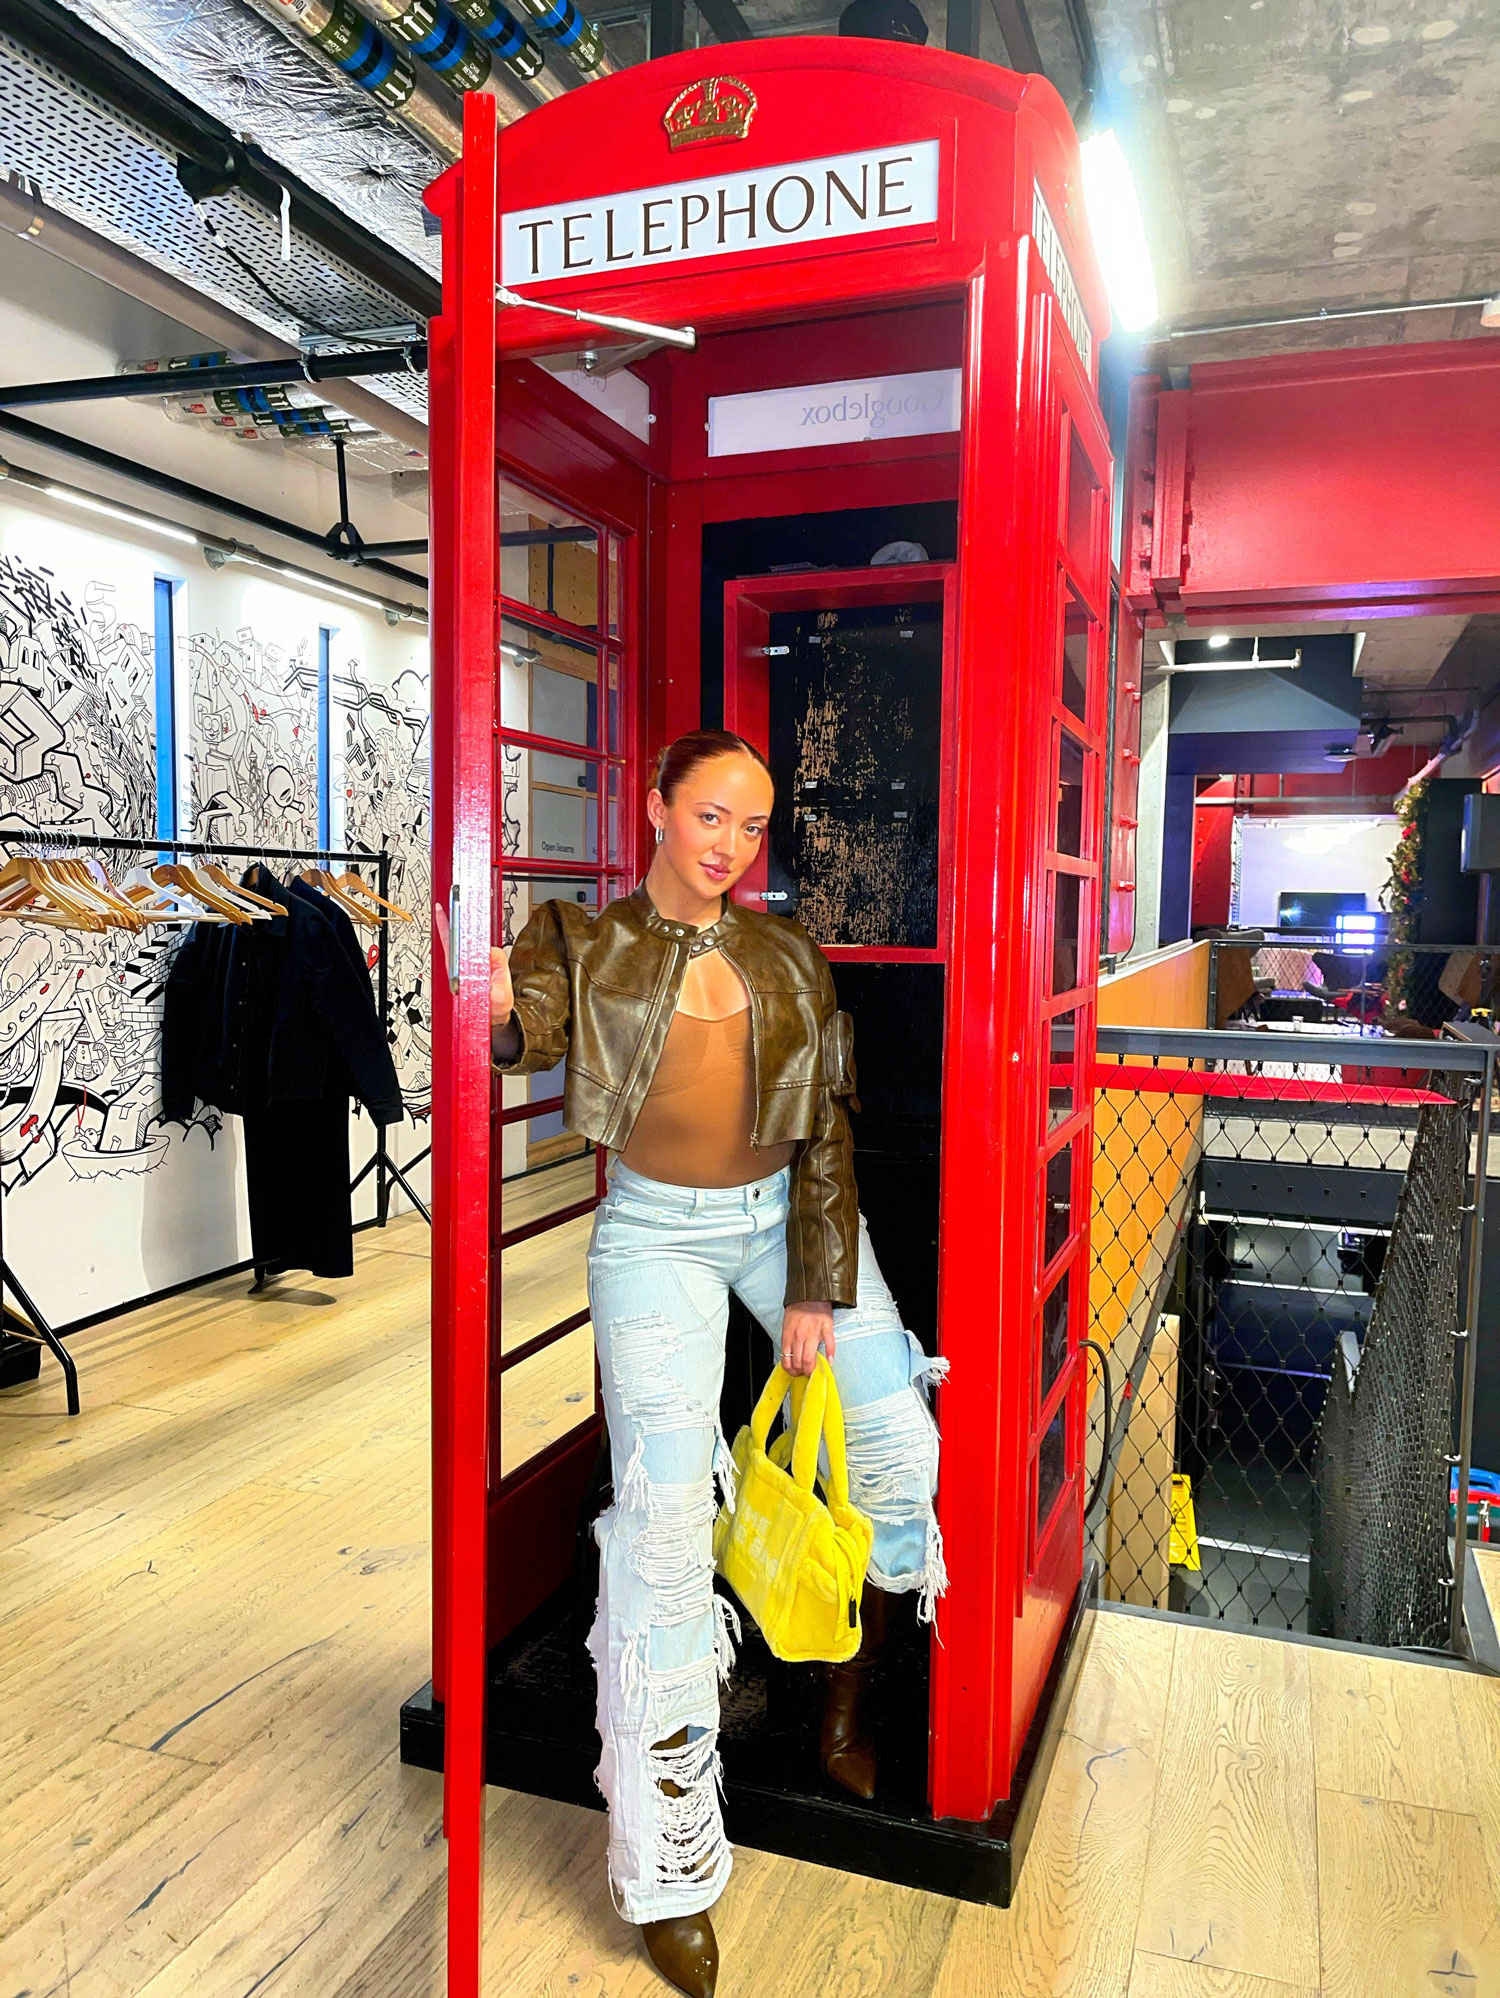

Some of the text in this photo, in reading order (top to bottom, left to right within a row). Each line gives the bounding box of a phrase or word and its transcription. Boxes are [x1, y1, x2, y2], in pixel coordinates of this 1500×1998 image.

[333, 30, 349, 44] FLOW
[578, 45, 595, 64] RETURN
[462, 66, 480, 83] RETURN
[518, 156, 914, 275] TELEPHONE
[1033, 193, 1090, 364] TELEPHONE
[541, 841, 575, 853] Open Sesame
